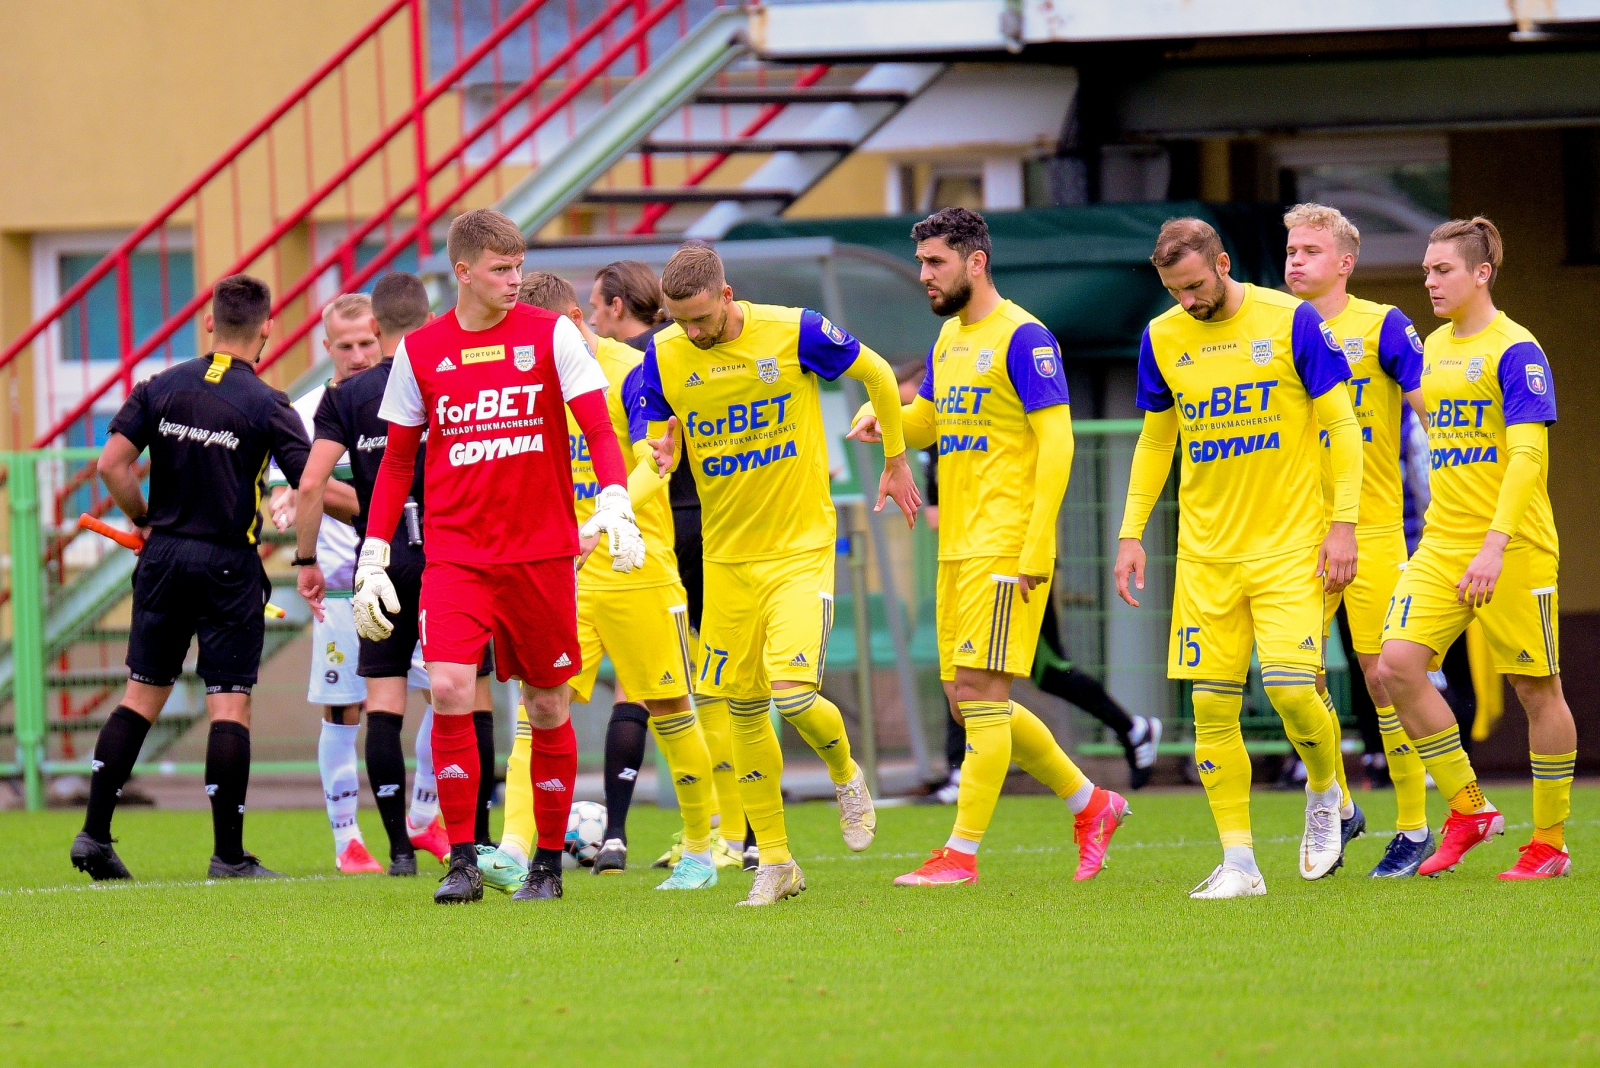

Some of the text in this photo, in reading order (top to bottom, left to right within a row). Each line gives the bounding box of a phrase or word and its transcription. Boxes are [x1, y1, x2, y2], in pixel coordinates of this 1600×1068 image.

[465, 350, 501, 359] FORTUNA
[1201, 343, 1238, 353] FORTUNA
[435, 364, 457, 373] adidas
[711, 363, 747, 373] FORTUNA
[1175, 360, 1195, 368] adidas
[684, 380, 705, 388] adidas
[436, 383, 544, 425] forBET
[1176, 380, 1279, 420] forBET
[686, 392, 792, 437] forBET
[1210, 414, 1282, 430] BUKMACHERSKIE
[441, 424, 475, 436] ZAKŁADY
[476, 417, 544, 431] BUKMACHERSKIE
[729, 422, 797, 446] BUKMACHERSKIE
[187, 426, 211, 442] nas
[203, 430, 240, 451] piłka
[448, 433, 544, 467] GDYNIA
[1189, 431, 1280, 464] GDYNIA
[702, 440, 798, 477] GDYNIA
[1384, 594, 1412, 631] 21
[1176, 626, 1201, 667] 15
[1297, 644, 1317, 652] adidas
[553, 659, 573, 669] adidas
[700, 642, 729, 686] 17
[324, 669, 339, 684] 9
[437, 772, 469, 780] adidas
[535, 782, 567, 792] adidas
